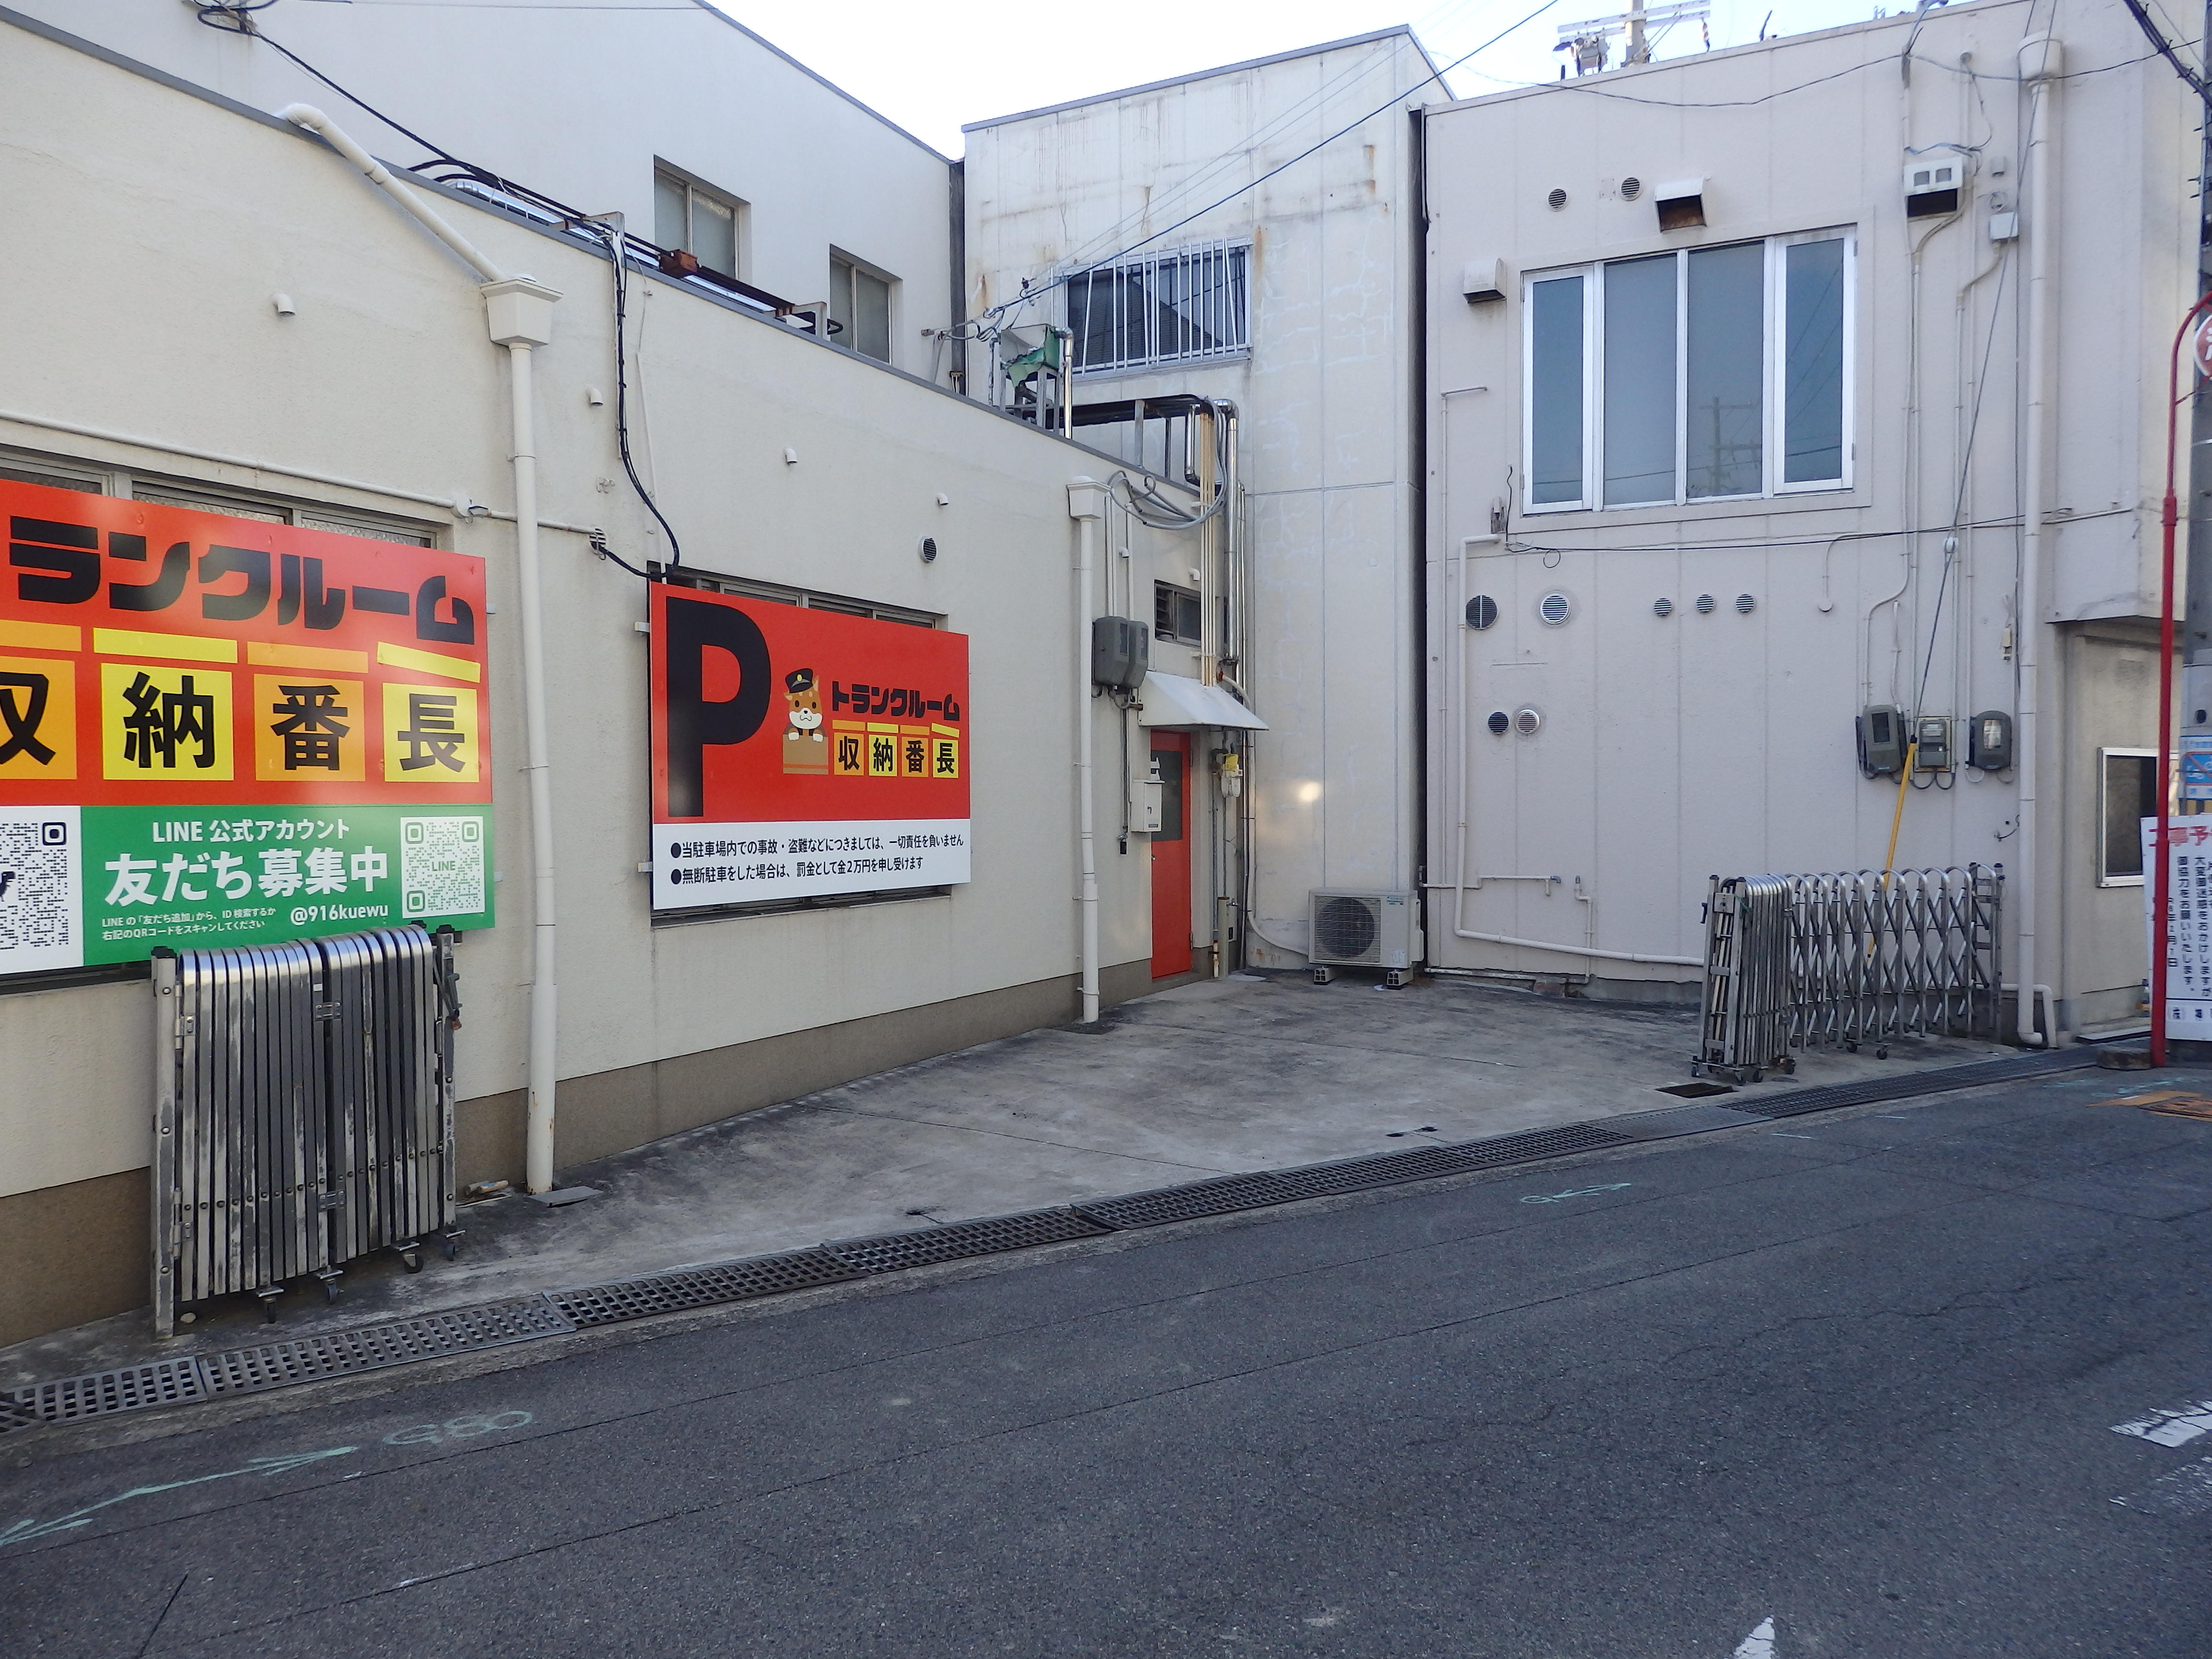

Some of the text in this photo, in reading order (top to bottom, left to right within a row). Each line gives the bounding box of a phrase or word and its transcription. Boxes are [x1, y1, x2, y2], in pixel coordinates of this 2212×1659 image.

[9, 516, 475, 645] ランクルーム
[666, 596, 771, 817] P
[832, 681, 960, 721] トランクルーム
[838, 735, 955, 774] 収納番長
[153, 818, 350, 843] LINE 公式アカウント
[104, 845, 388, 907] 友だち募集中
[432, 860, 456, 872] LINE
[102, 917, 124, 927] LINE
[290, 903, 389, 926] @916kuewu
